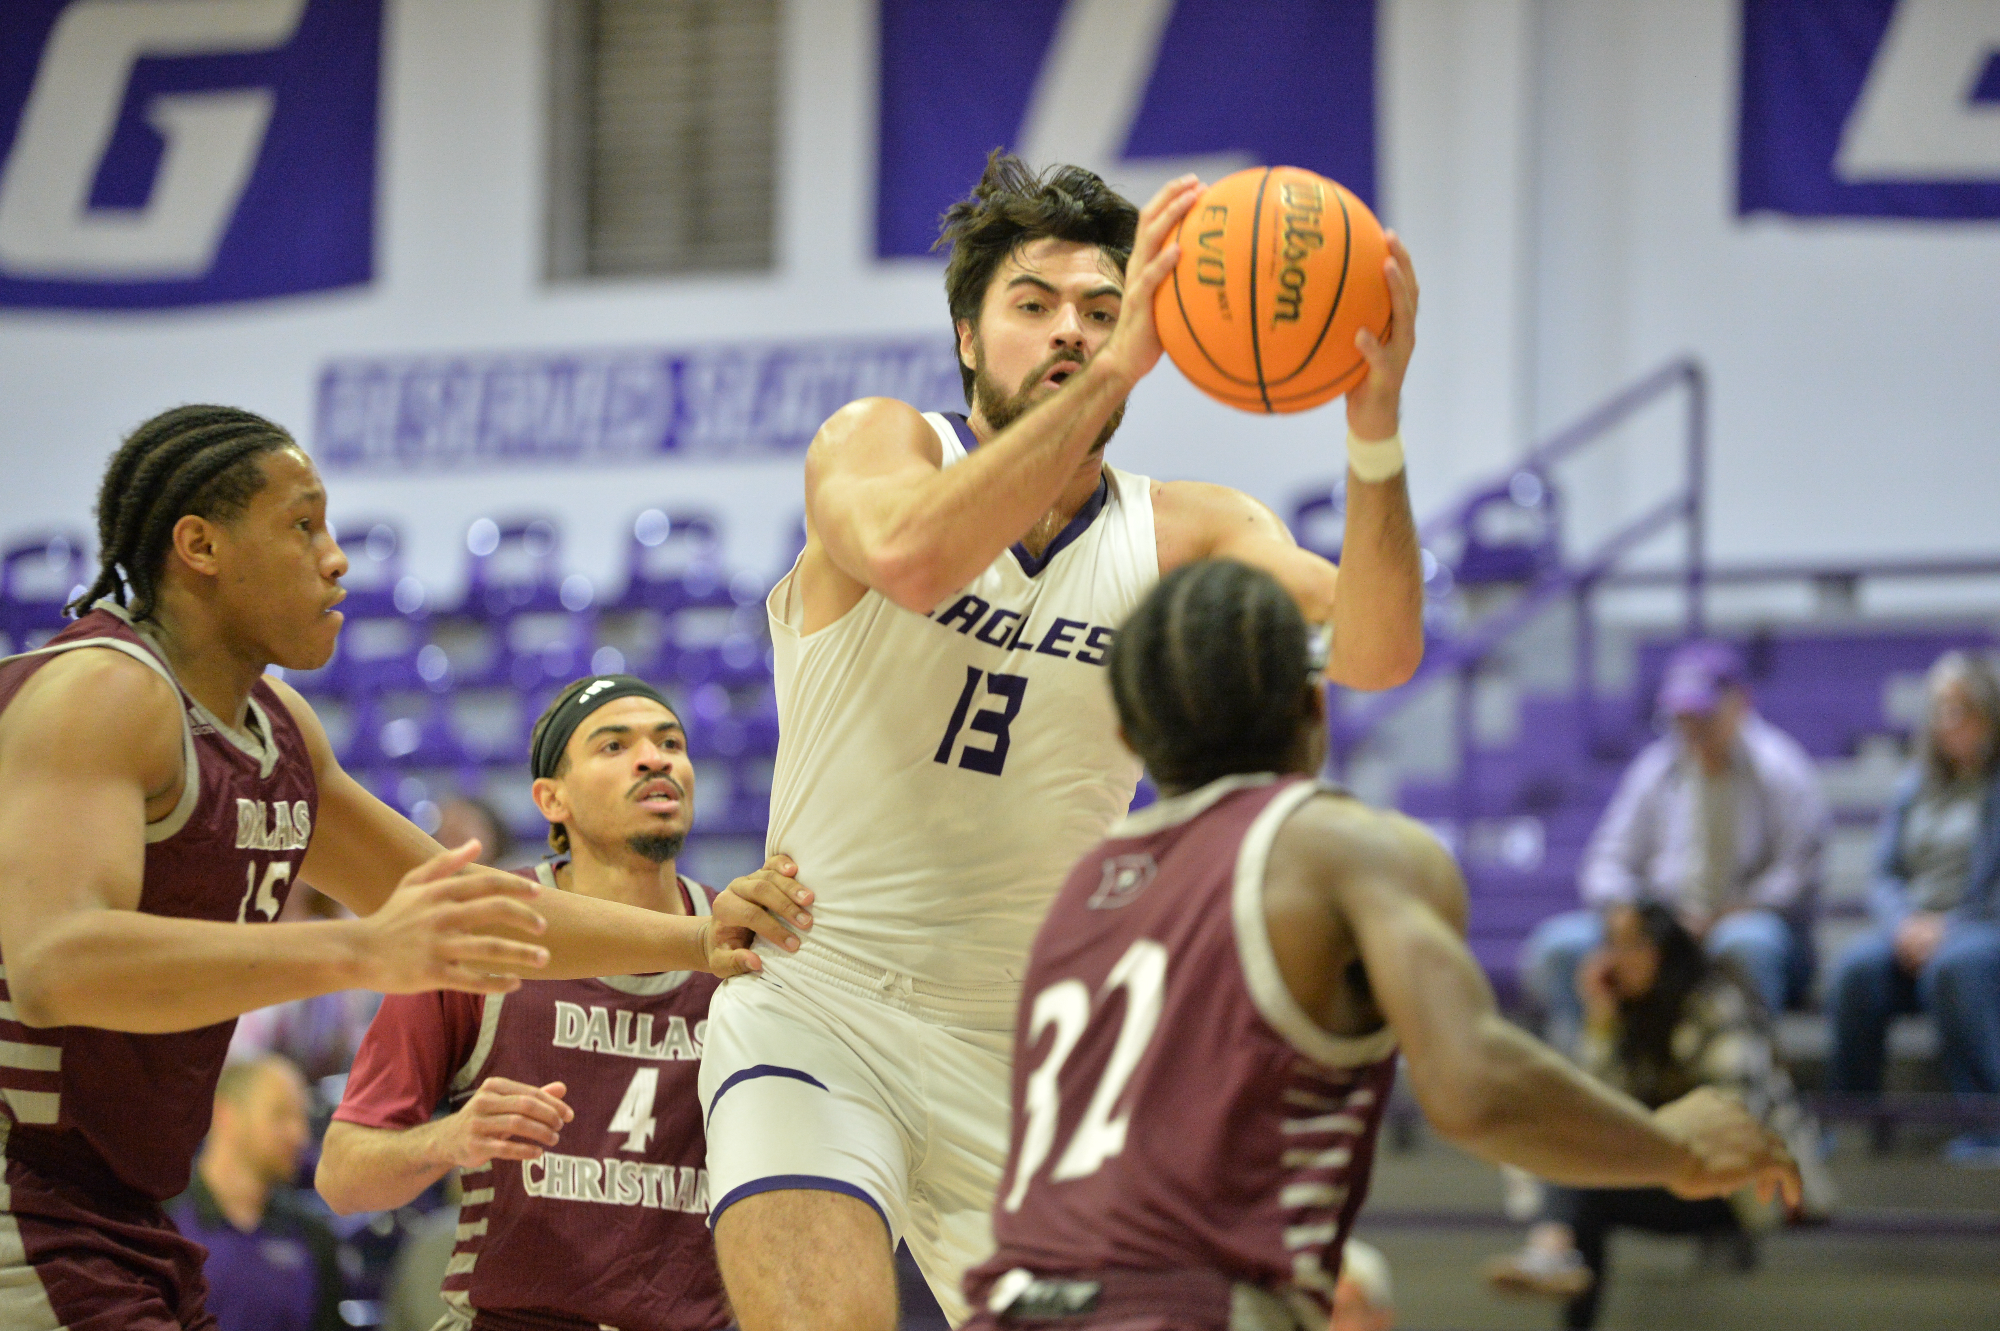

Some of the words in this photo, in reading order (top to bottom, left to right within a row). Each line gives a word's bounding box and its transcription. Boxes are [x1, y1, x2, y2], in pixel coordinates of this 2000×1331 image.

[0, 0, 302, 280] G
[1197, 205, 1229, 288] EVO
[1273, 181, 1325, 324] Wilson
[927, 594, 1118, 668] AGLES
[933, 665, 1029, 777] 13
[607, 1067, 660, 1154] 4
[1004, 938, 1169, 1213] 32
